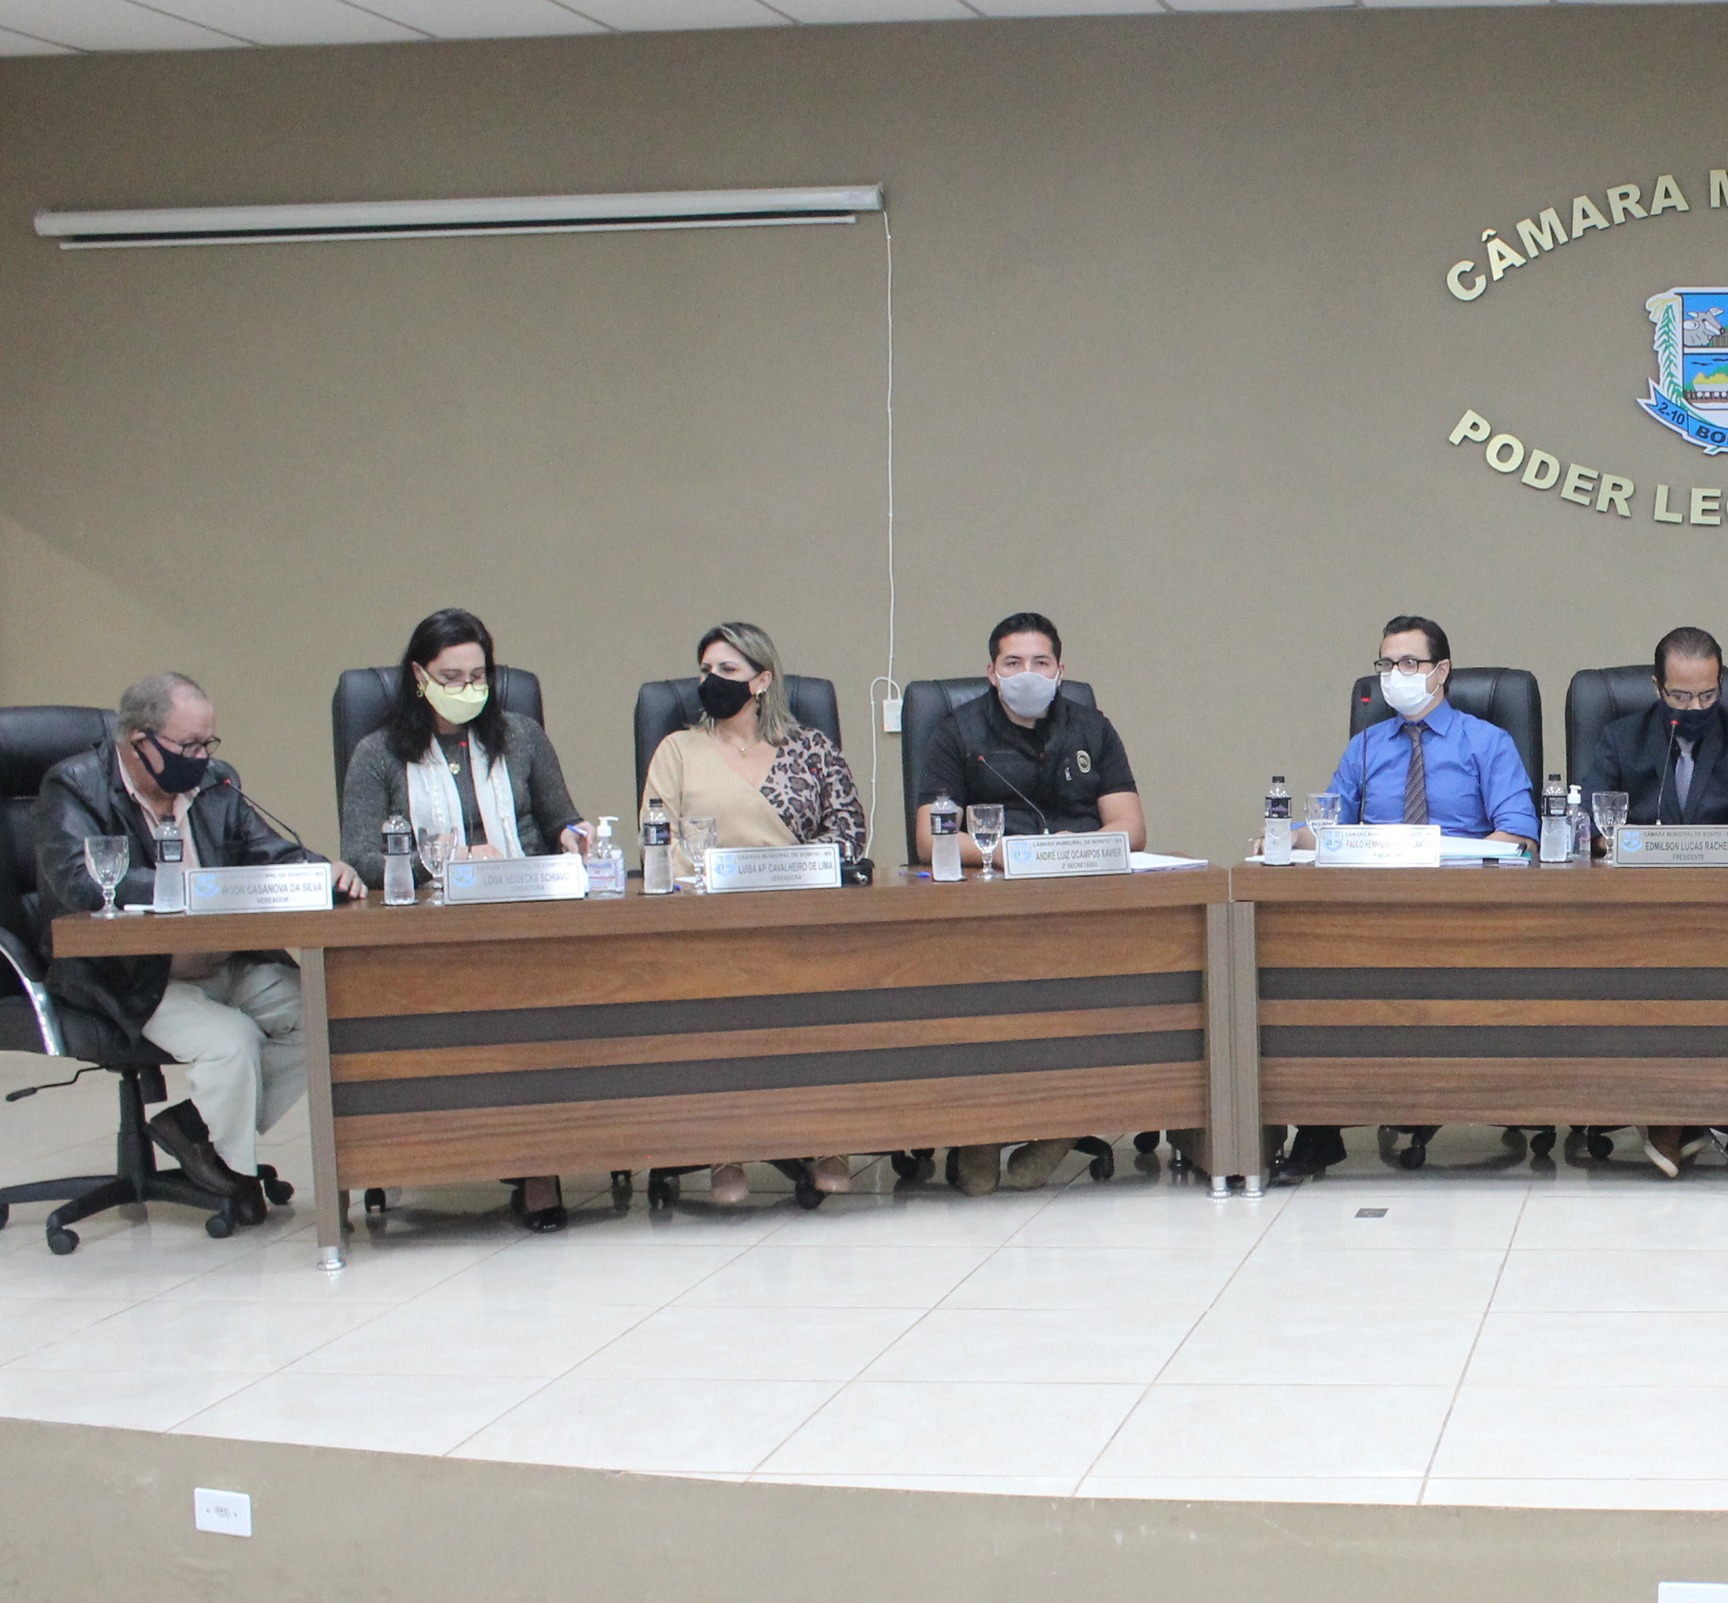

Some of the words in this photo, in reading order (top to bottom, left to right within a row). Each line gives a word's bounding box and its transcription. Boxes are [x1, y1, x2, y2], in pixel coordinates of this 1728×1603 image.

[1446, 174, 1690, 301] CÂMARA
[1657, 402, 1686, 425] 2-10
[1448, 408, 1636, 517] PODER
[1071, 848, 1100, 860] OCAMPOS
[1645, 841, 1679, 851] EDMILSON
[1681, 841, 1703, 851] LUCAS
[290, 883, 300, 892] DA
[302, 882, 322, 891] SILVA
